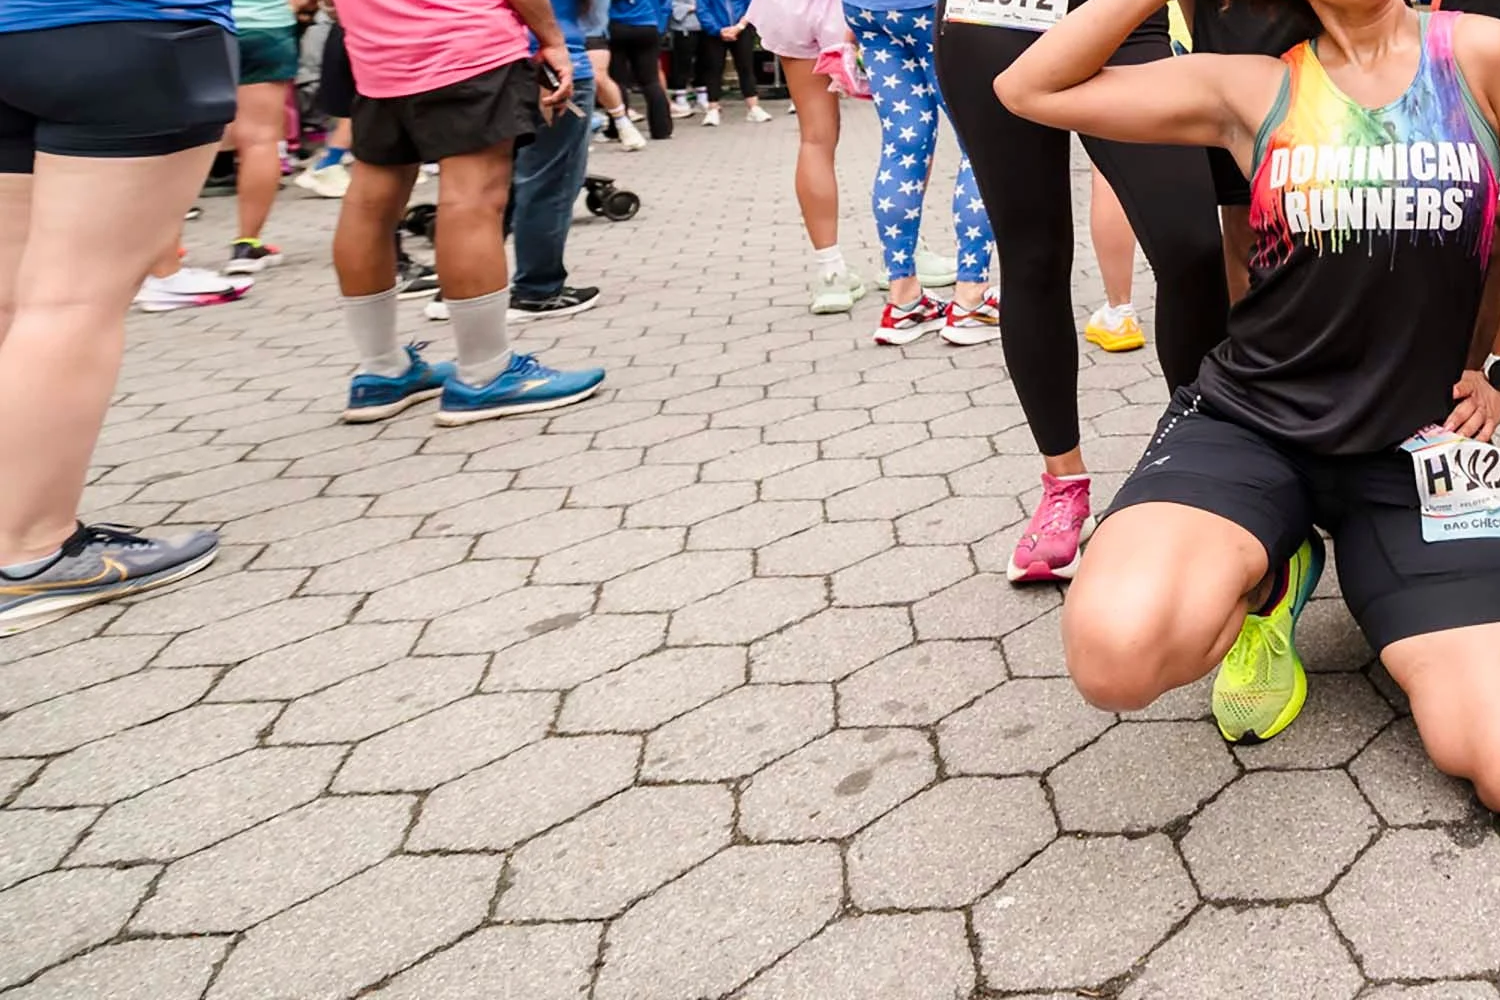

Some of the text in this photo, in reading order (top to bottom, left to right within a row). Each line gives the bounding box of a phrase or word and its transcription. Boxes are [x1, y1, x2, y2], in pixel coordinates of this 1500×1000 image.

[1270, 141, 1480, 189] DOMINICAN
[1424, 453, 1453, 495] H
[1443, 520, 1468, 531] BAG
